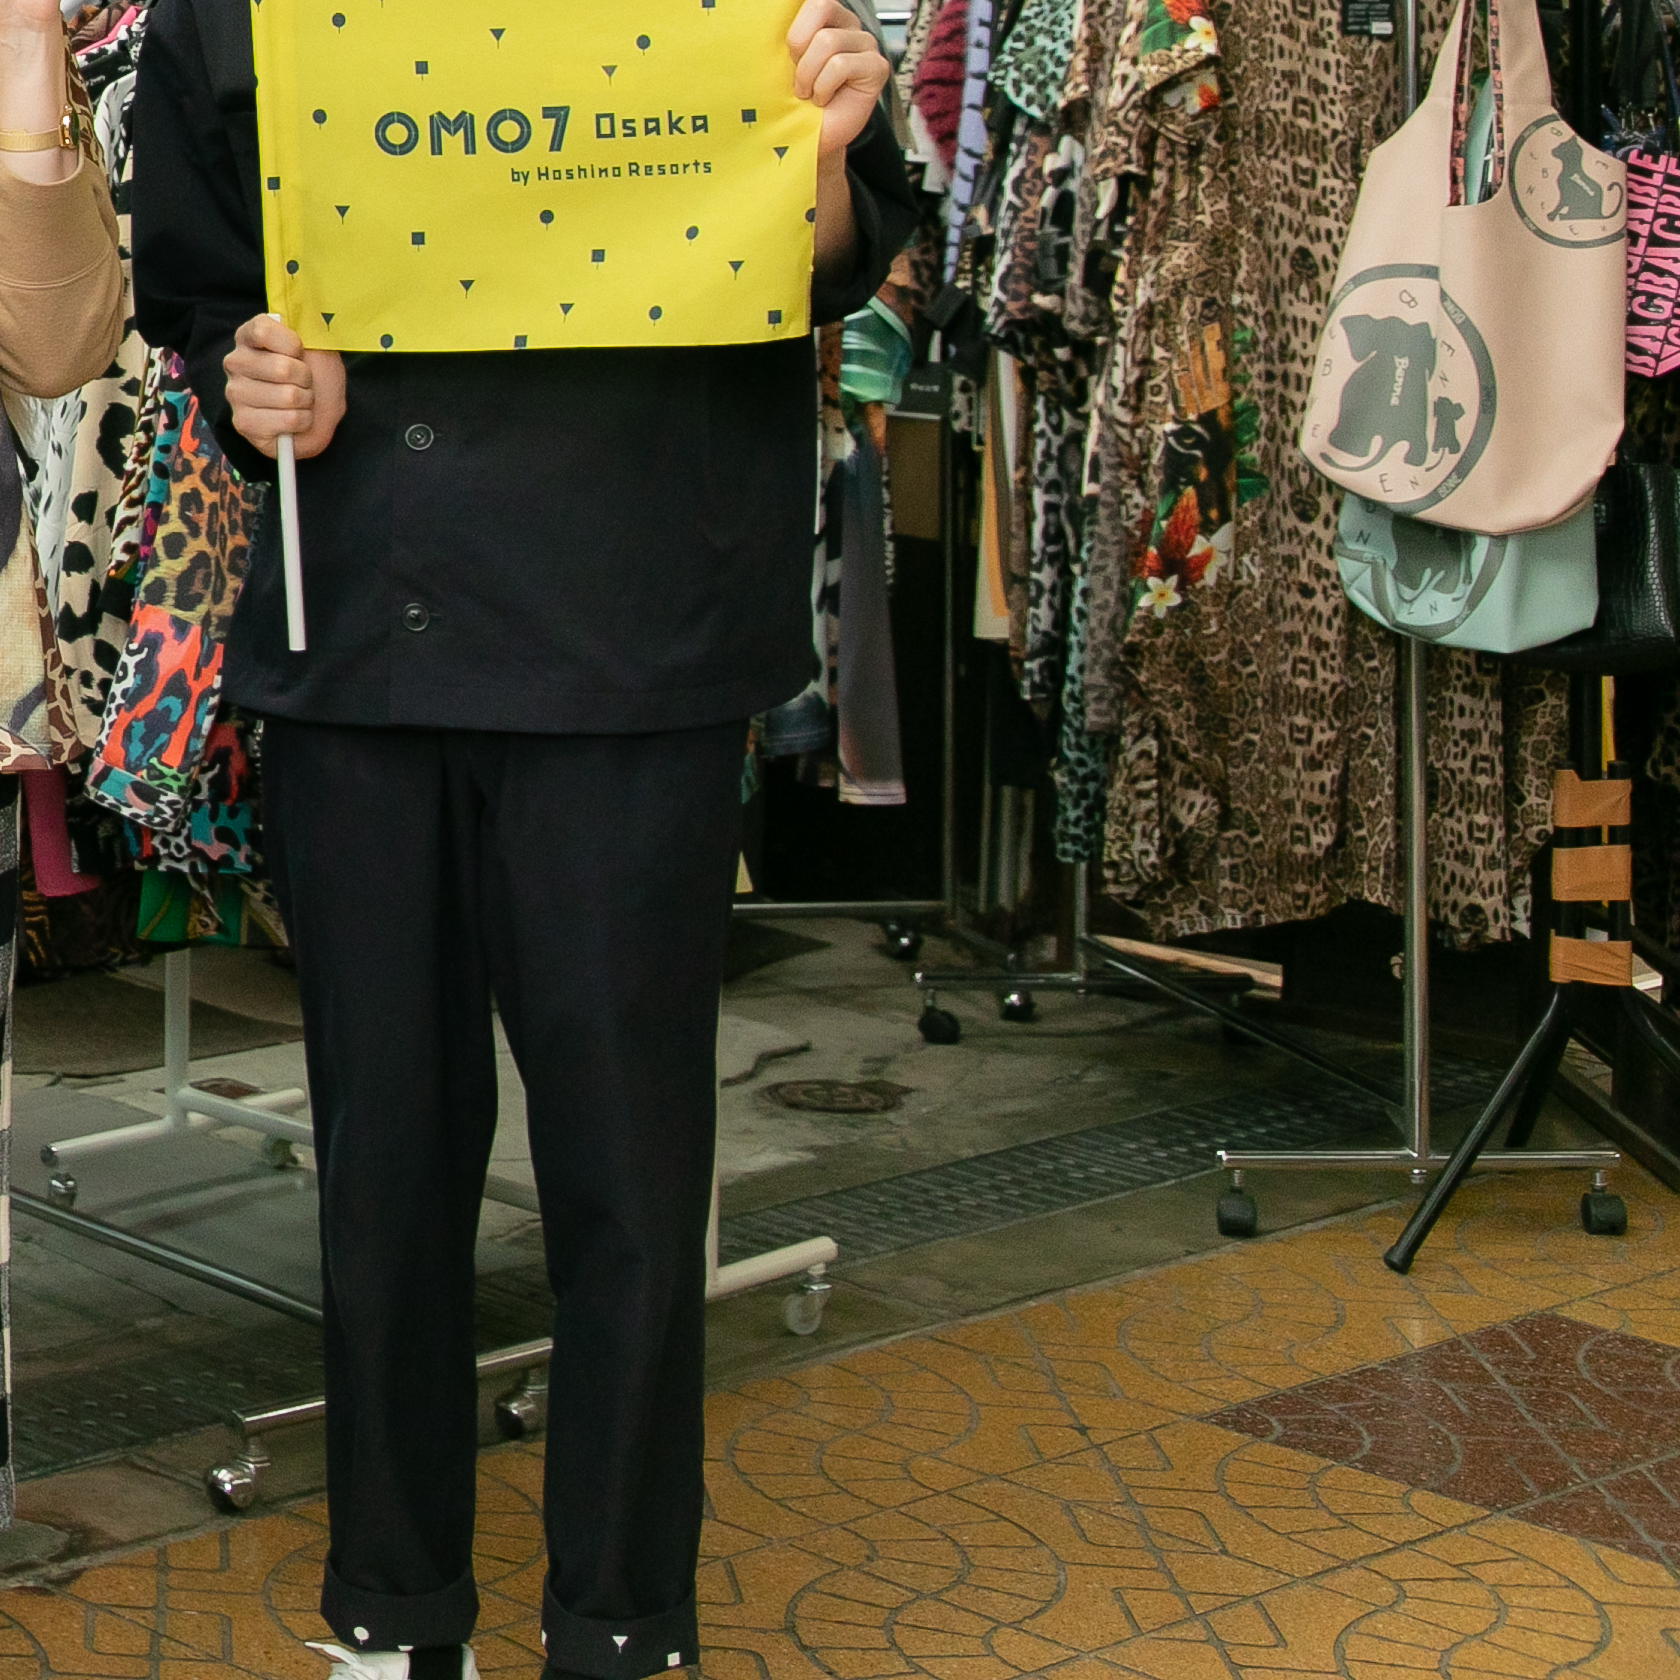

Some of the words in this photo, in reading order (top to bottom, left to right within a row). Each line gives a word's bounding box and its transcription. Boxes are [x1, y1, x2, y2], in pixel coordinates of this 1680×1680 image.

[374, 105, 571, 156] OMO7
[595, 110, 709, 140] Osaka
[511, 167, 530, 187] by
[537, 163, 622, 182] Hoshino
[628, 159, 712, 178] Resorts
